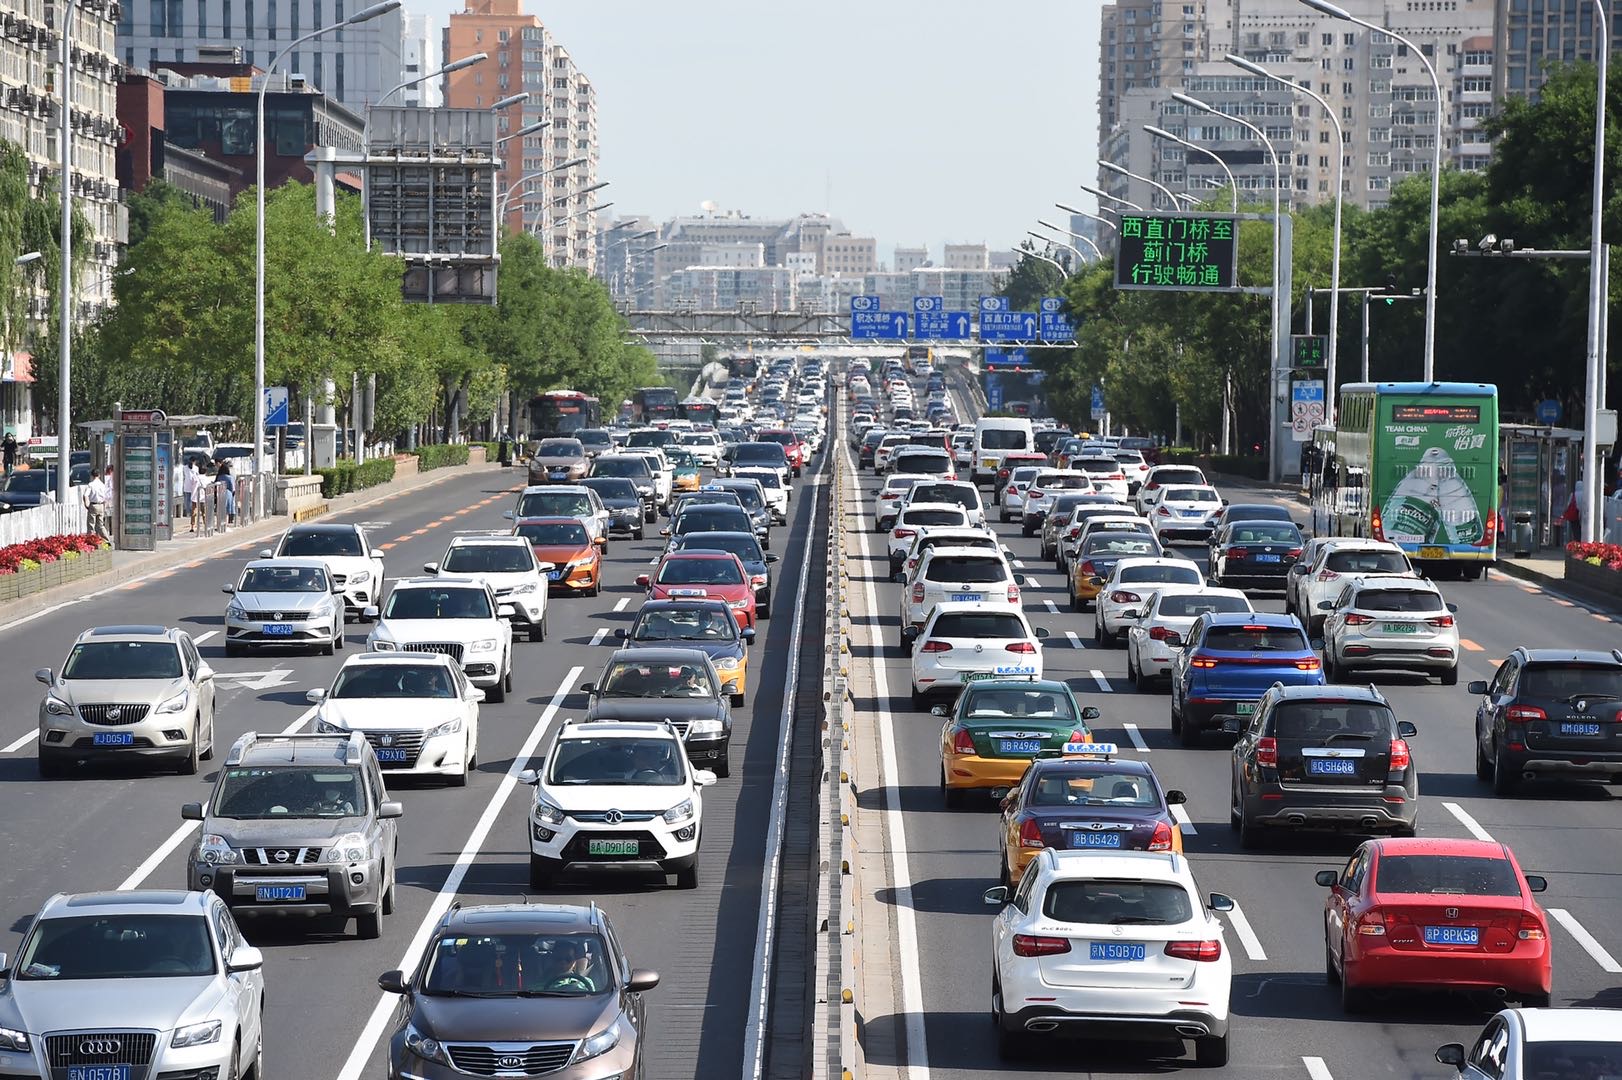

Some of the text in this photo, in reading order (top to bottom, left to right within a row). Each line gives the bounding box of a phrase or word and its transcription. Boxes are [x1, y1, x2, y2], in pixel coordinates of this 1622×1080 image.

[1122, 217, 1232, 240] 西直门桥至
[1143, 240, 1208, 263] 蓟门桥
[1131, 263, 1219, 285] 行驶畅通
[919, 299, 931, 308] 33
[984, 314, 1021, 323] 西直门桥
[1385, 425, 1428, 433] TEAM CHINA
[377, 750, 406, 761] 79XY0
